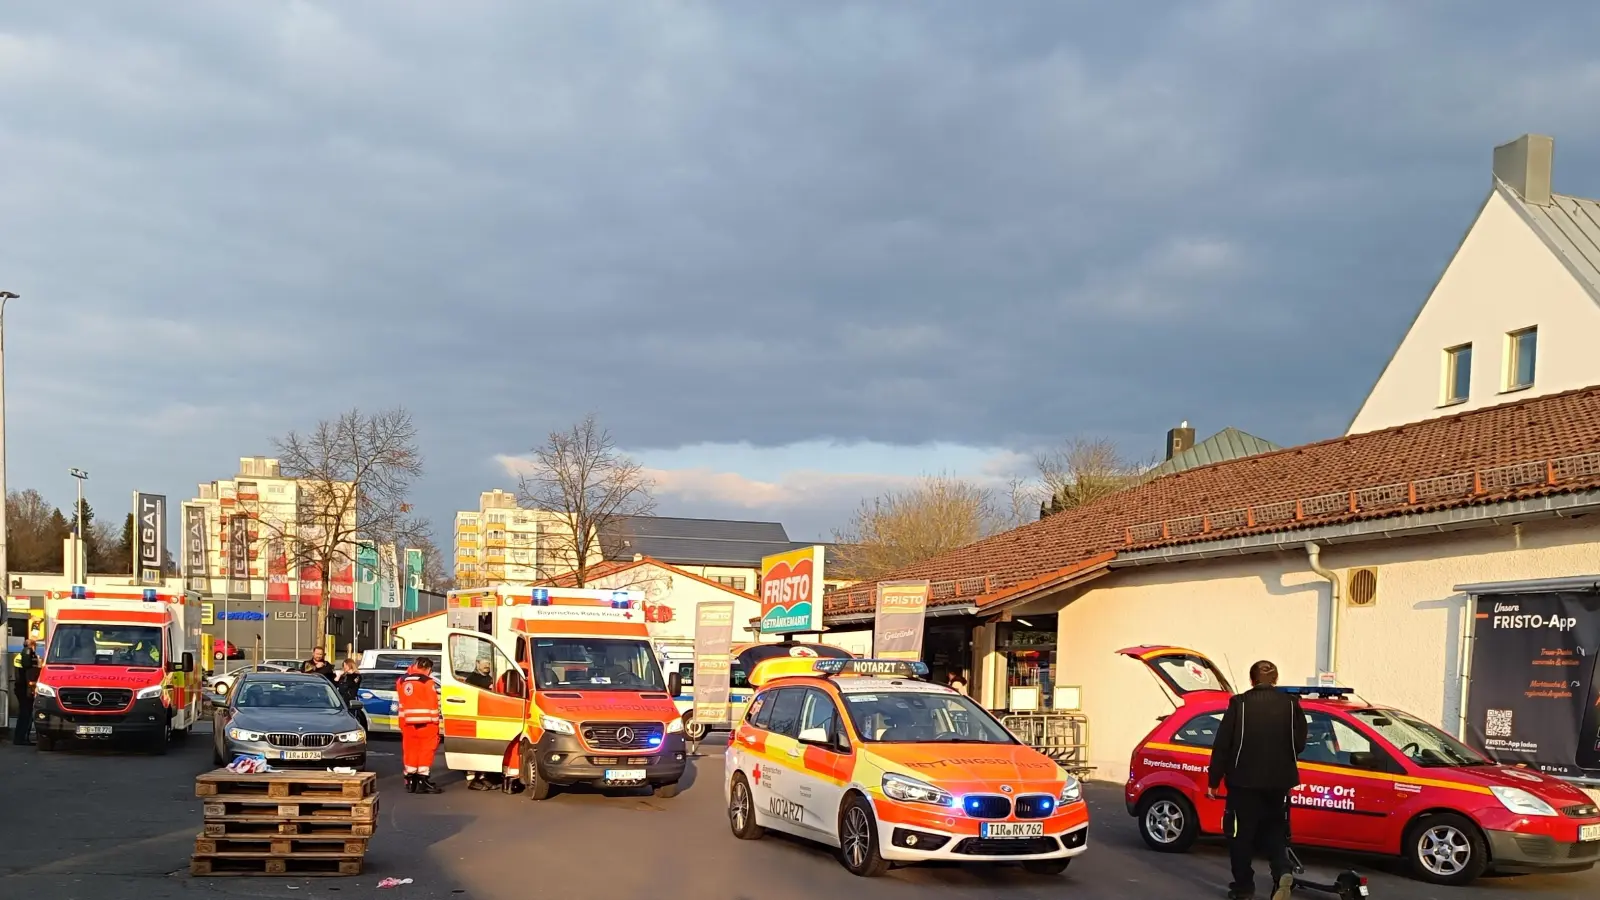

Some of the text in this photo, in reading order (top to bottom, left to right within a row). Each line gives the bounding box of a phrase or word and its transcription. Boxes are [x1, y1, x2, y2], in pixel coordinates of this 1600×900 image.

[143, 498, 161, 567] LEGAT
[190, 510, 206, 575] LEGAT
[235, 518, 248, 578] LEGAT
[332, 584, 354, 595] NKD
[764, 574, 810, 605] FRISTO
[884, 595, 924, 605] FRISTO
[645, 605, 673, 622] KD
[1494, 602, 1520, 613] Unsere
[275, 611, 307, 621] LEGAT
[763, 615, 810, 629] GETRÄNKEMARKT
[1493, 614, 1577, 632] FRISTO-App
[853, 661, 898, 674] NOTARZT
[1486, 739, 1520, 749] FRISTO-App
[905, 757, 1050, 769] RETTUNGSDIENST
[1143, 758, 1181, 769] Bayerisches
[1182, 762, 1201, 772] Rotes
[1293, 783, 1355, 799] er vor Ort
[769, 797, 804, 823] NOTARZT
[1291, 795, 1355, 811] chenreuth
[989, 822, 1042, 836] TIR RK 762
